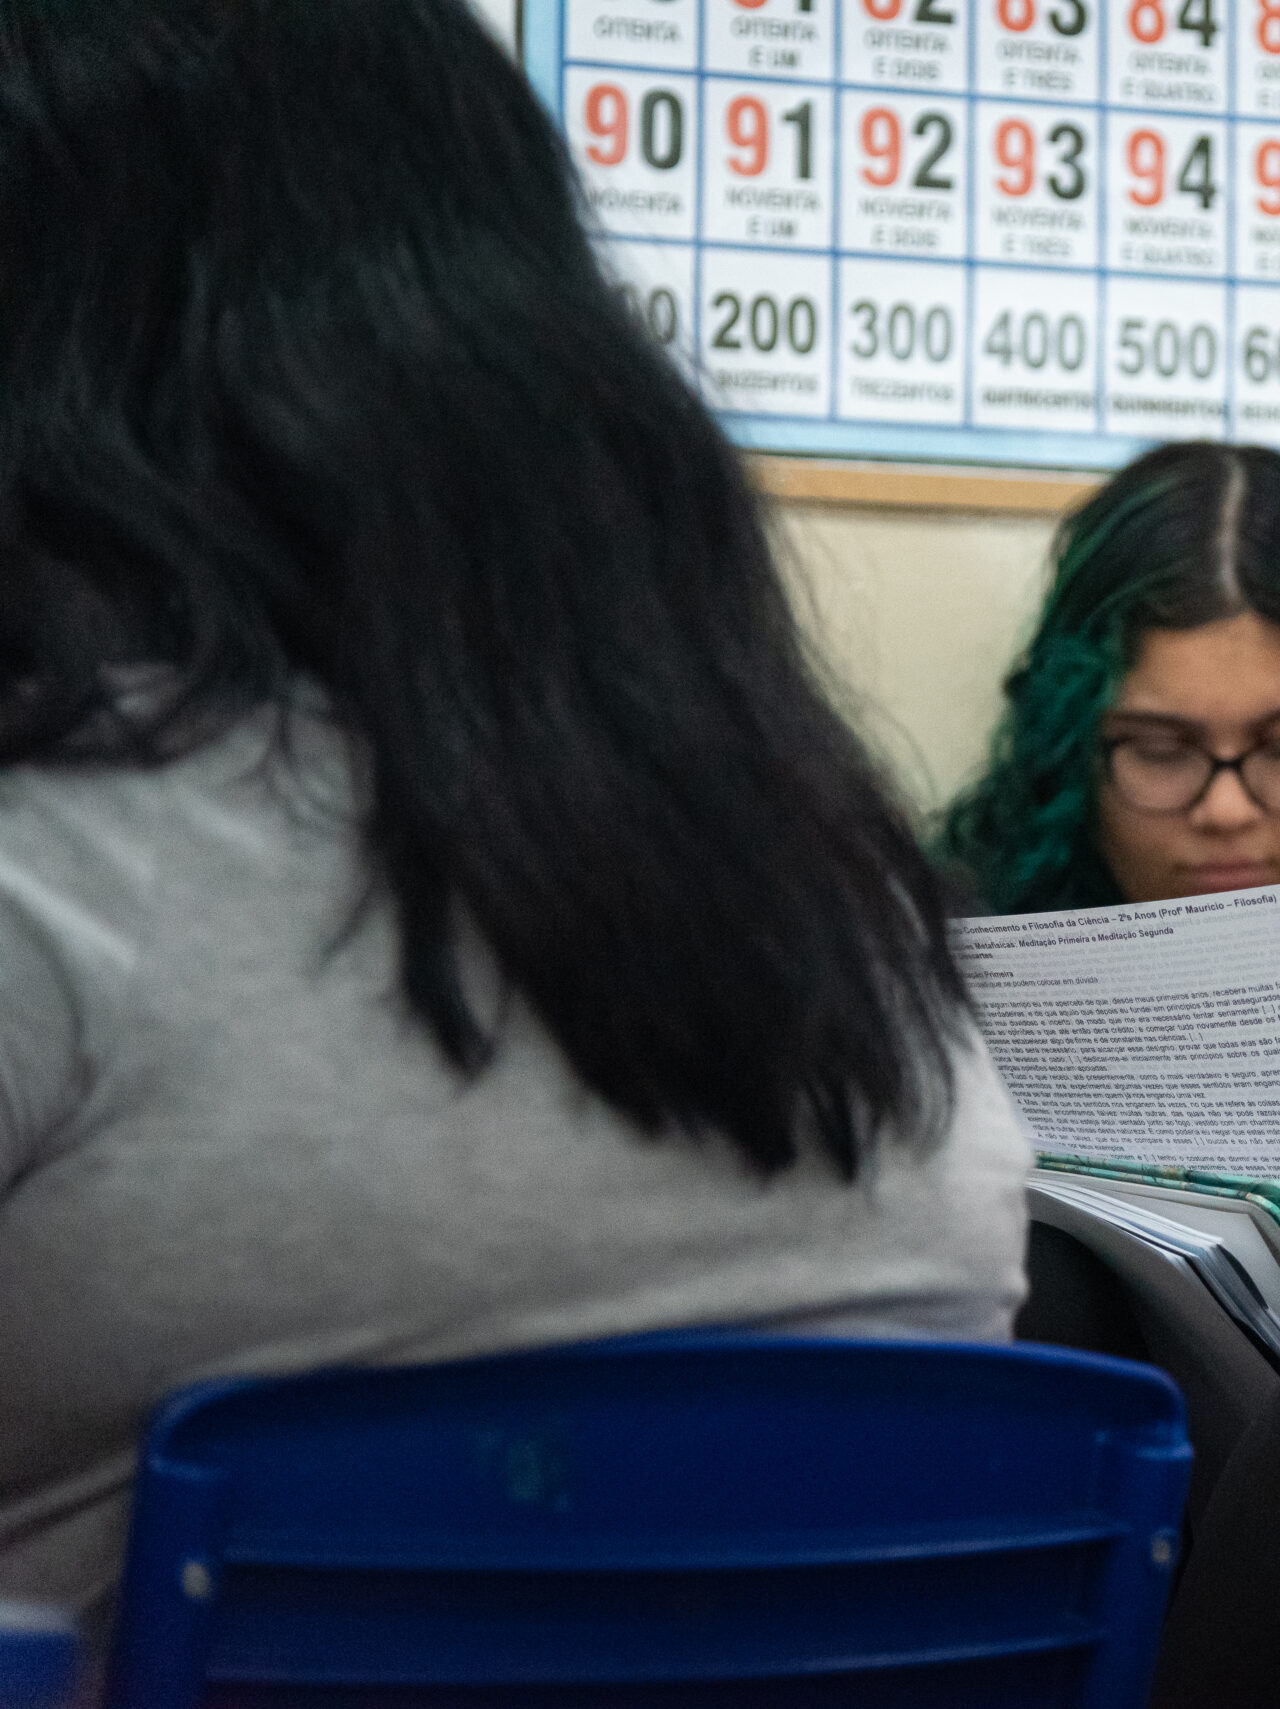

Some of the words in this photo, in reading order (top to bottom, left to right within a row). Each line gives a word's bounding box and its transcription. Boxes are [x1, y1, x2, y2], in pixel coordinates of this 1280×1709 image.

[585, 82, 684, 169] 90
[727, 95, 811, 180] 91
[861, 107, 954, 189] 92
[994, 119, 1086, 200] 93
[1128, 130, 1217, 209] 94
[712, 293, 816, 354] 200
[852, 300, 953, 363] 300
[984, 311, 1085, 371] 400
[1118, 317, 1216, 380] 500
[1018, 937, 1056, 947] Meditação
[1058, 935, 1089, 944] Primeira
[1097, 930, 1136, 941] Meditação
[1138, 926, 1174, 938] Segunda
[1028, 919, 1064, 929] Filosofia
[1065, 918, 1076, 926] da
[1077, 915, 1109, 925] Ciência
[1134, 911, 1156, 920] Anos
[1233, 894, 1277, 908] Filosofia)
[1215, 998, 1230, 1007] mal
[1248, 984, 1274, 993] muitas
[1196, 1020, 1236, 1029] novamente
[1239, 1017, 1262, 1026] desde
[1202, 1043, 1216, 1051] que
[1217, 1040, 1239, 1048] todas
